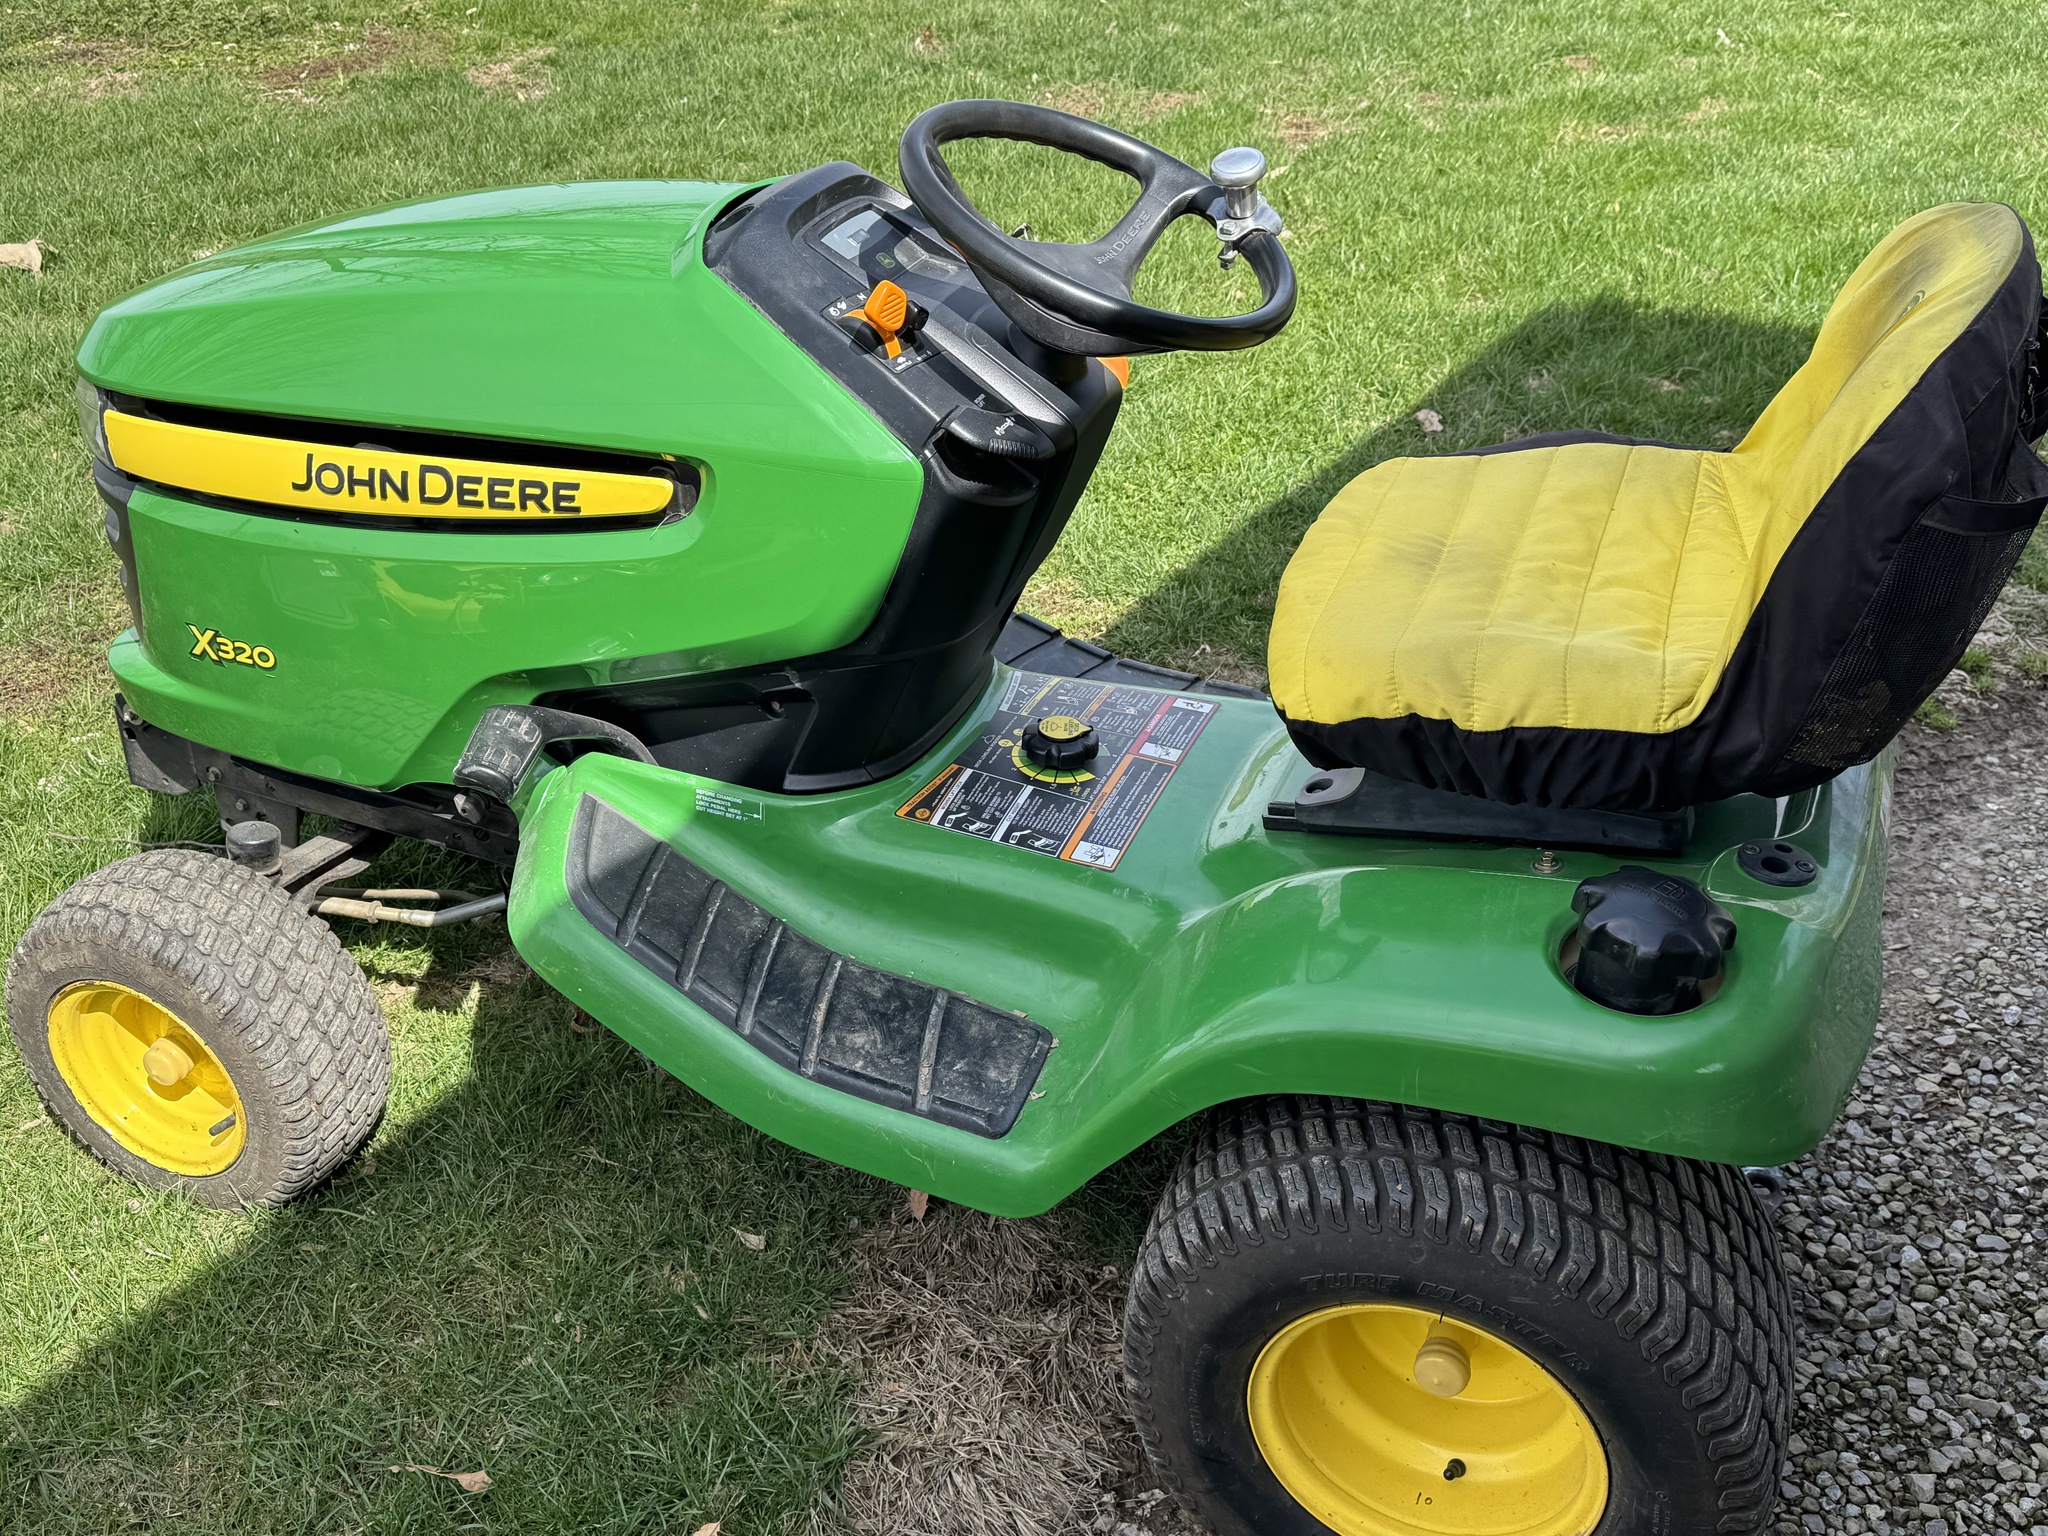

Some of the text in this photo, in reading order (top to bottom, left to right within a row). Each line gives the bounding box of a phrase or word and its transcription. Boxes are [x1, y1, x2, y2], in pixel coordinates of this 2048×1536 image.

[1093, 210, 1151, 265] JOHN DEERE
[291, 453, 582, 515] JOHN DEERE
[186, 622, 277, 671] X320
[696, 788, 742, 804] BEFORE CHANGING
[696, 794, 731, 807] ATTACHMENTS
[696, 799, 710, 807] LOCK
[710, 803, 726, 811] PEDAL
[1300, 1272, 1401, 1292] TURF
